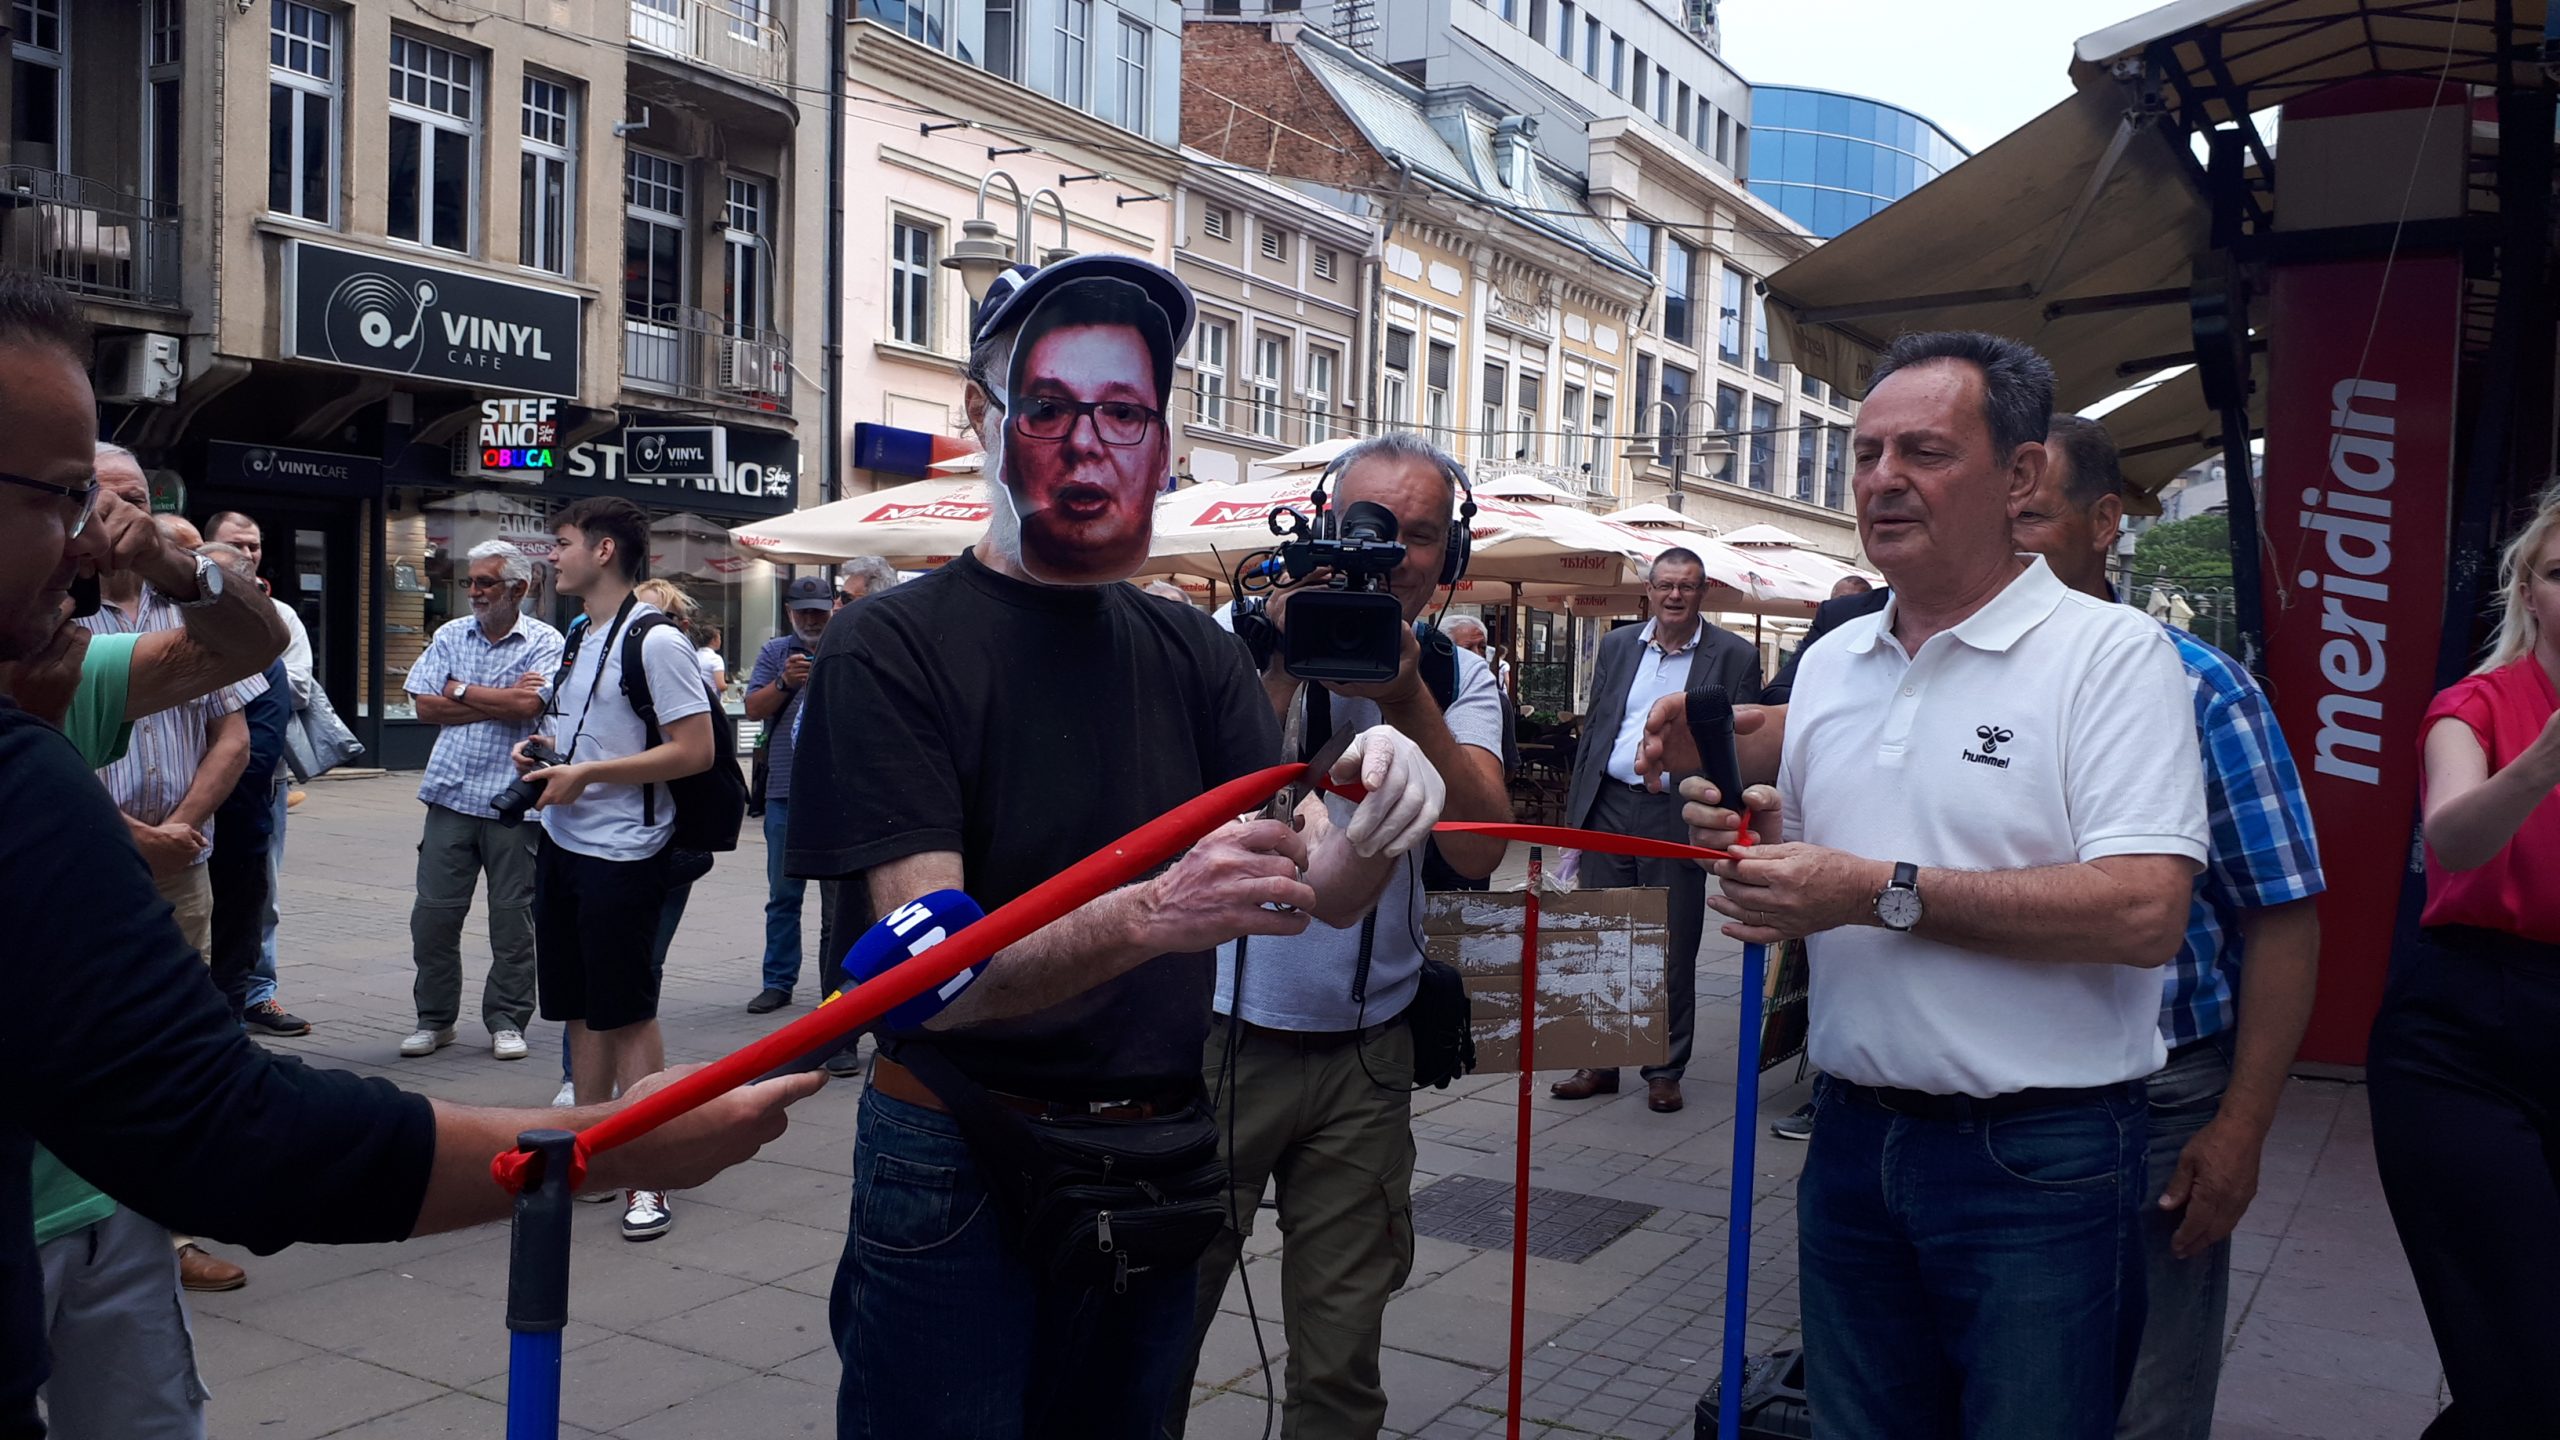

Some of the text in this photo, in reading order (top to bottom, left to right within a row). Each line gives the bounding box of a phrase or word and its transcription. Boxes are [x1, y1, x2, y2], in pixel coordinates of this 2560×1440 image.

[441, 311, 551, 361] VINYL
[448, 350, 502, 370] CAFE
[481, 398, 557, 423] STEF
[480, 423, 537, 446] ANO
[483, 449, 553, 467] OBUCA
[668, 447, 704, 460] VINYL
[764, 467, 791, 483] Shoe
[765, 481, 788, 496] Art
[876, 503, 989, 521] Nektar
[2298, 377, 2397, 785] meridian
[1961, 748, 2011, 769] hummel
